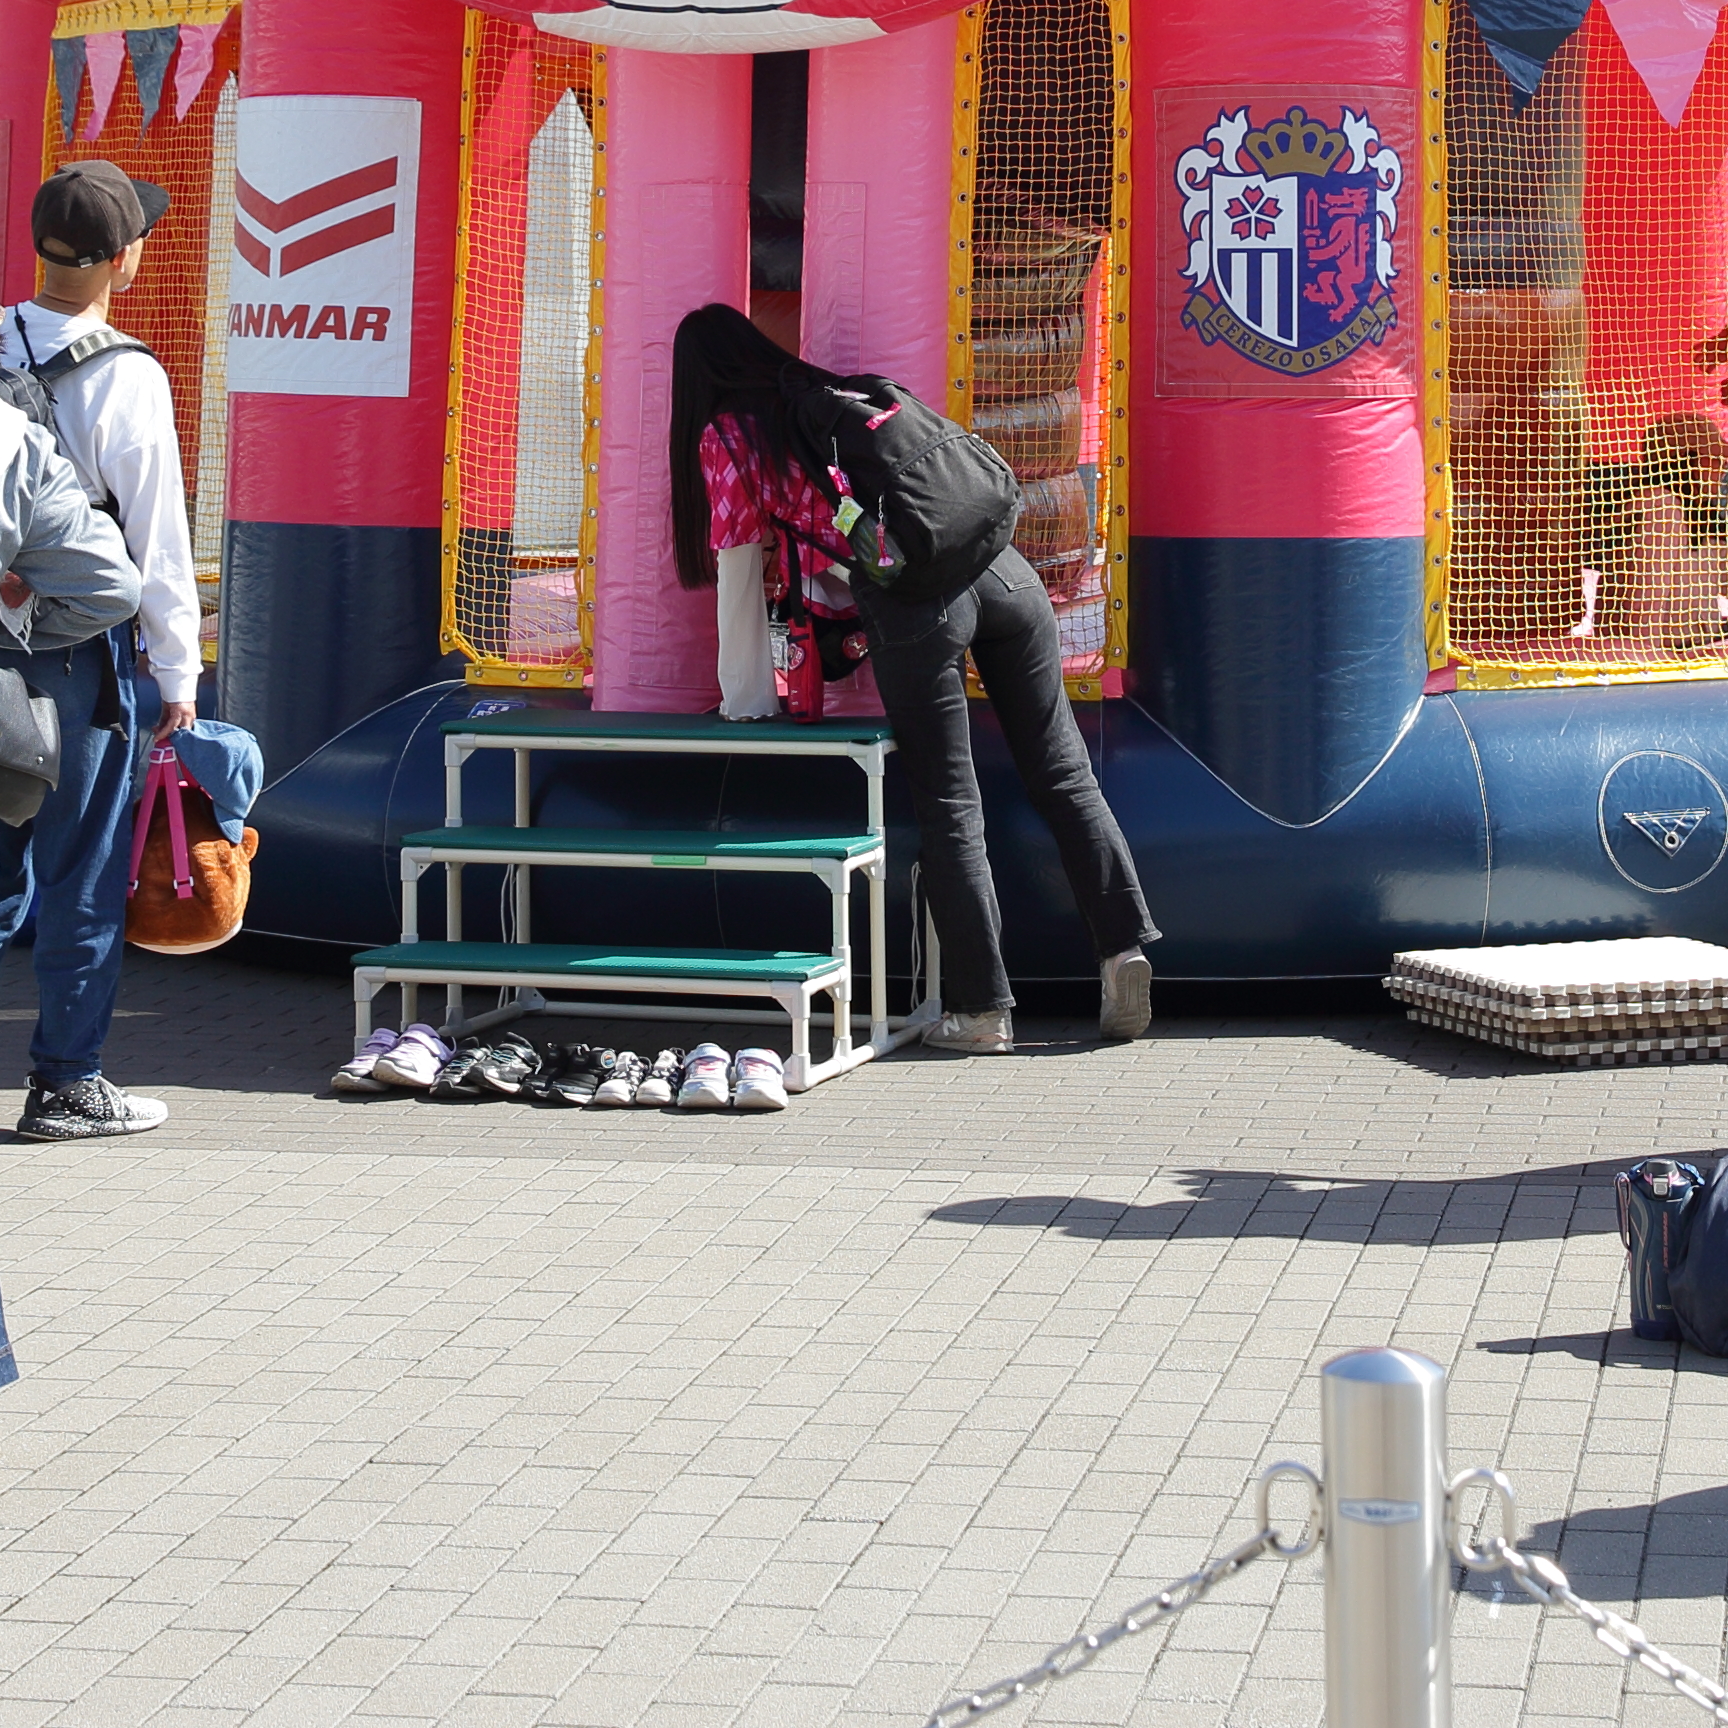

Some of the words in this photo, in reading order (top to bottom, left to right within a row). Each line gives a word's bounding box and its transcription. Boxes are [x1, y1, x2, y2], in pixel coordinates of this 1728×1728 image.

[227, 302, 391, 342] ANMAR
[1215, 311, 1293, 368] CEREZO
[1302, 313, 1372, 369] OSAKA
